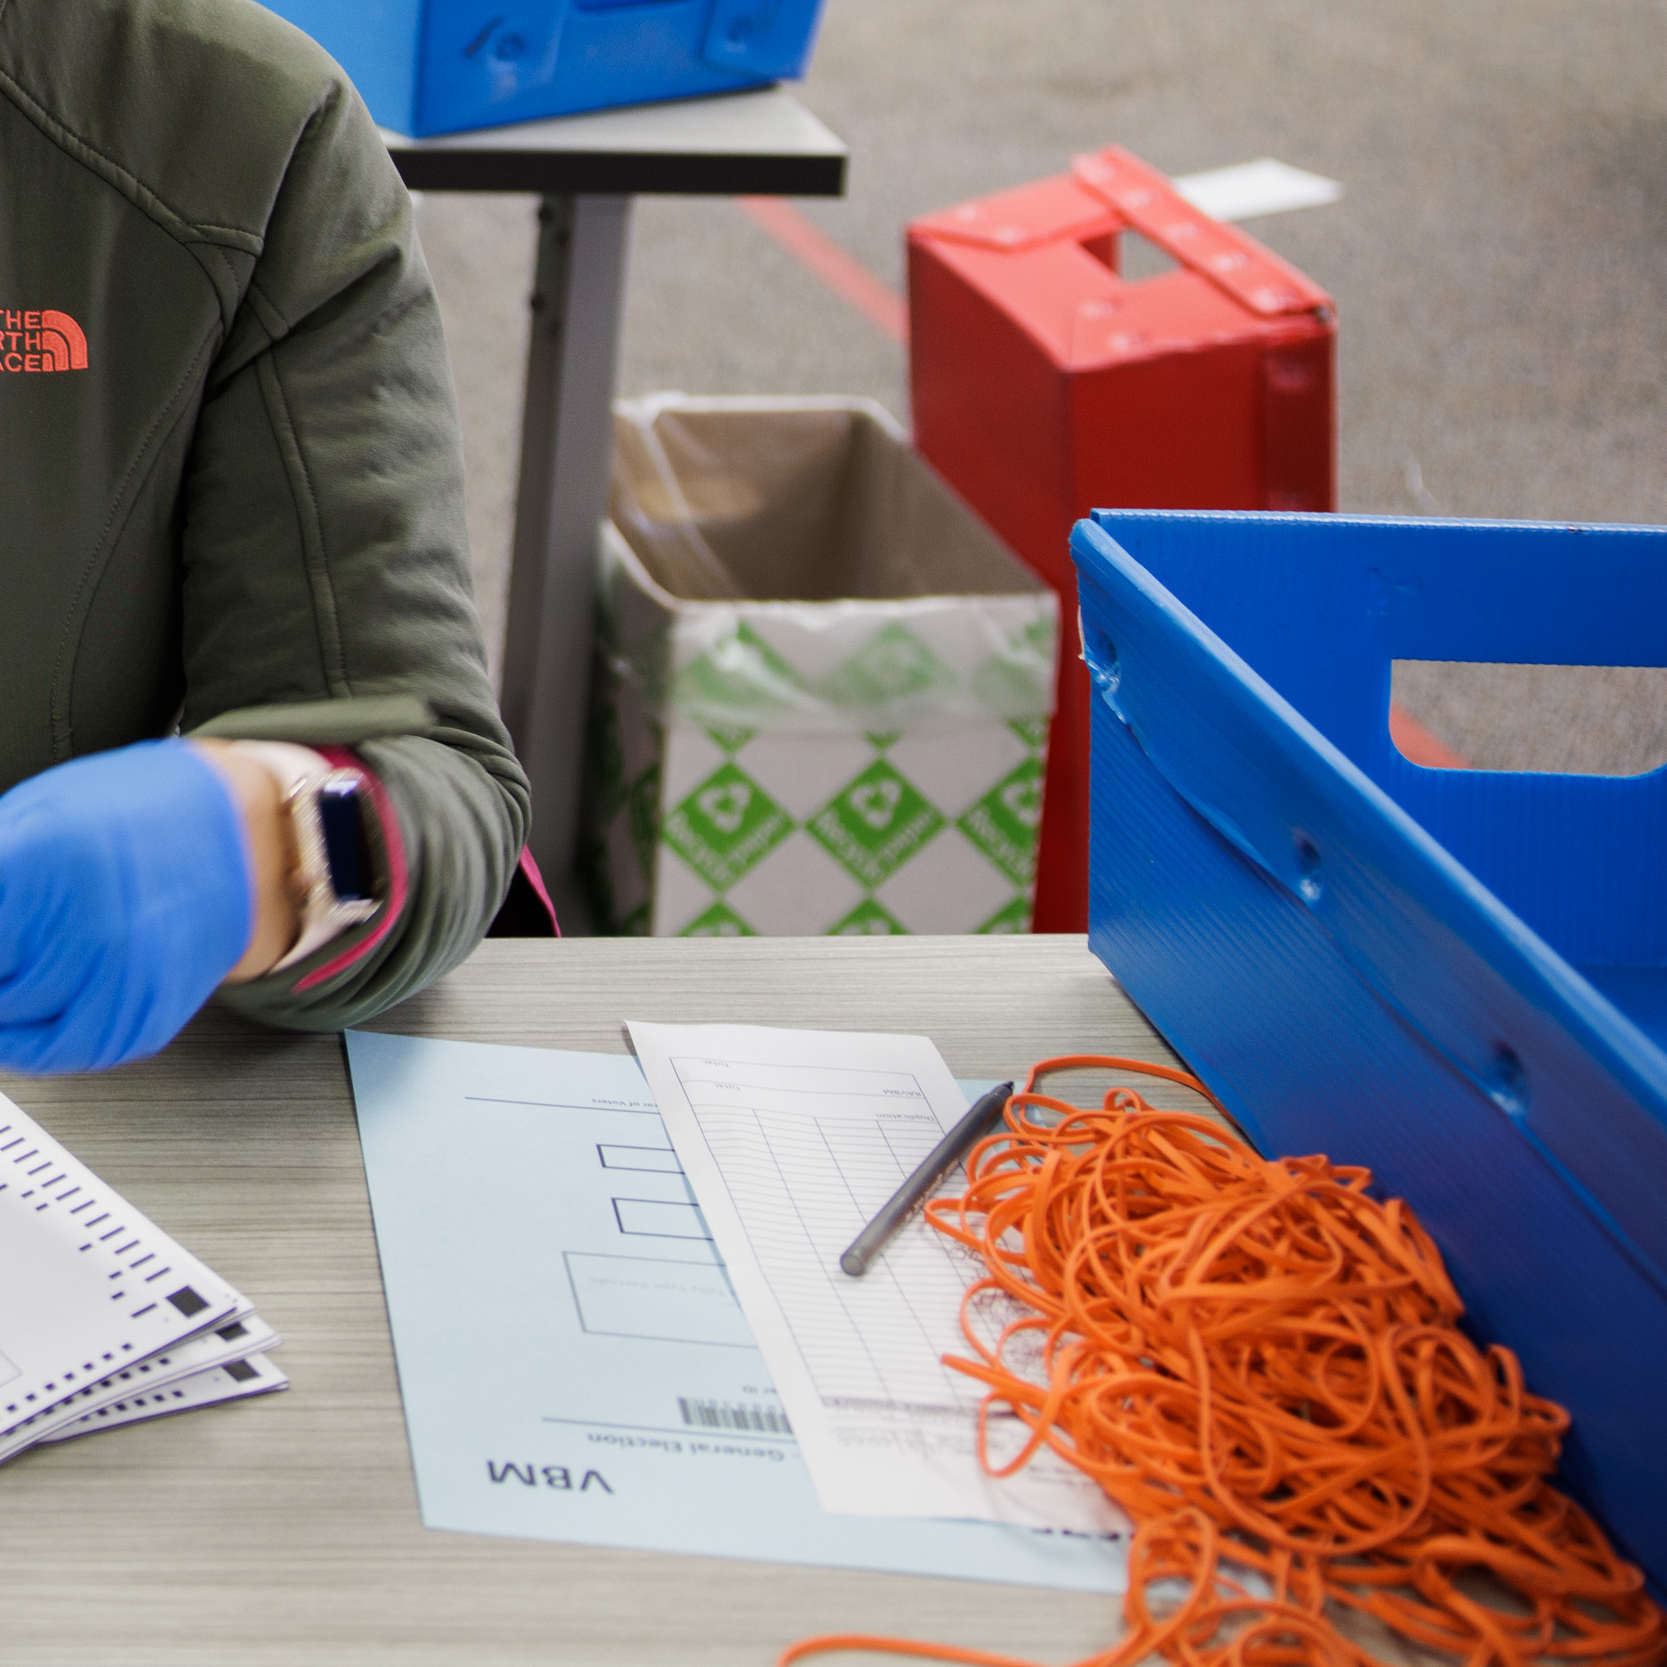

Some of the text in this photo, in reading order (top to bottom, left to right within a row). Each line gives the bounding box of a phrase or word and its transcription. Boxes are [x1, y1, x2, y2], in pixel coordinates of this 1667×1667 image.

[883, 1087, 924, 1098] RAVBM
[874, 1111, 937, 1124] Duplication
[586, 1430, 786, 1464] General Election
[485, 1458, 617, 1496] VBM
